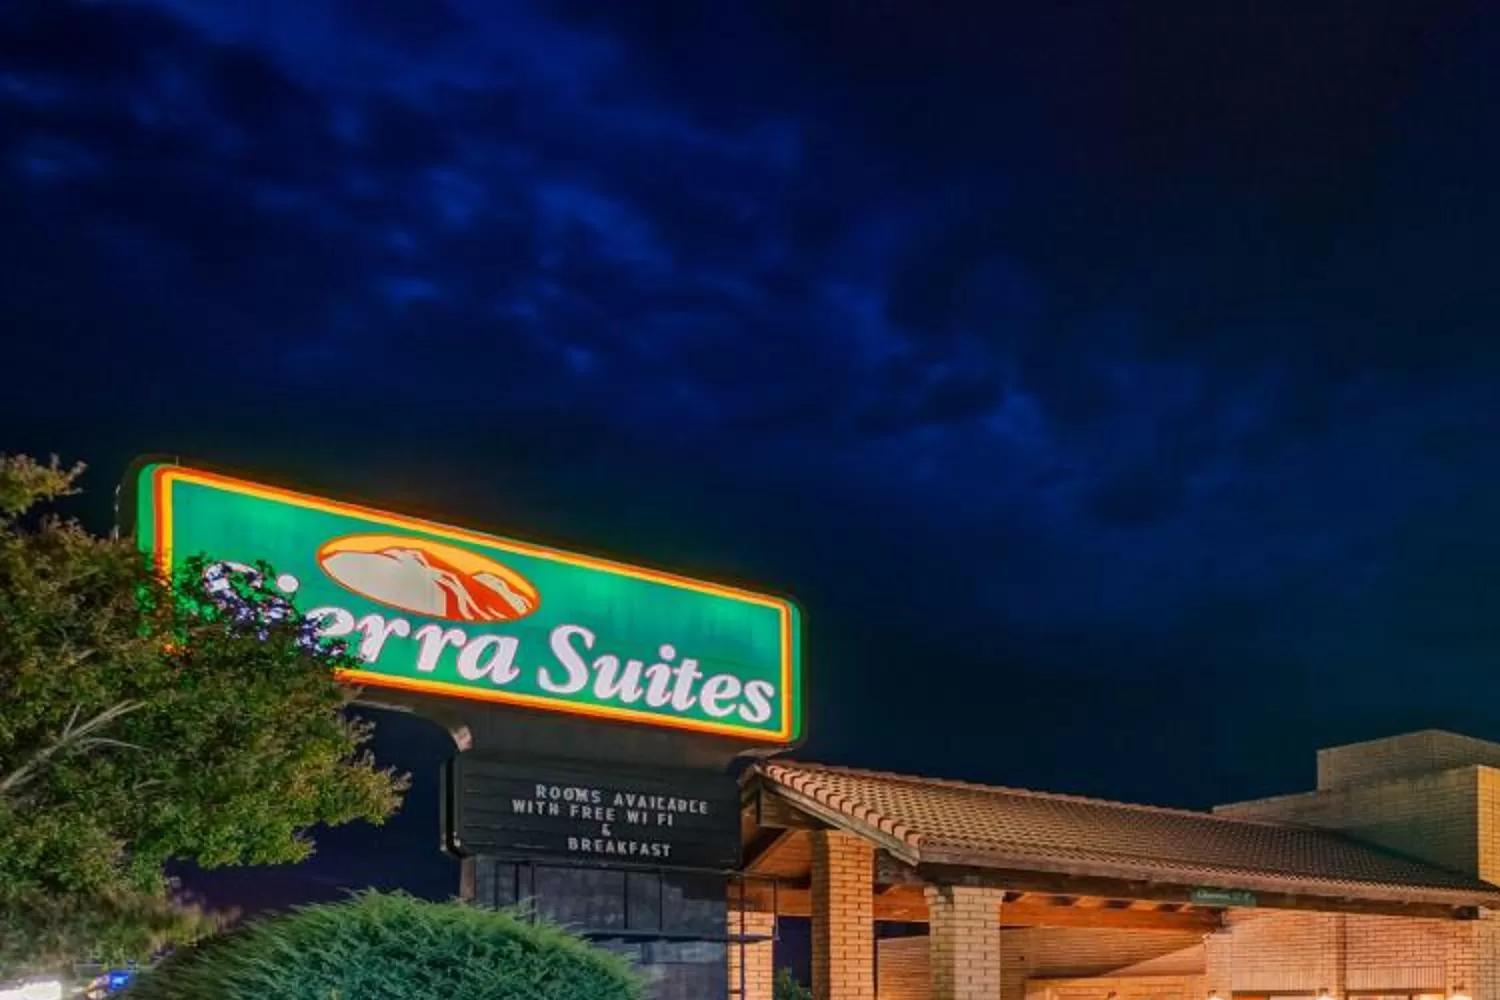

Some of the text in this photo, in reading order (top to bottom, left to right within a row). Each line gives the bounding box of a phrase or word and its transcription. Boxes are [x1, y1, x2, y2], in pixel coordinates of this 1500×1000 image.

[202, 560, 775, 724] Serra Suites
[535, 783, 601, 804] ROOMS
[511, 799, 561, 817] WITH
[569, 804, 616, 822] FREE
[567, 837, 672, 858] BREAKFAST
